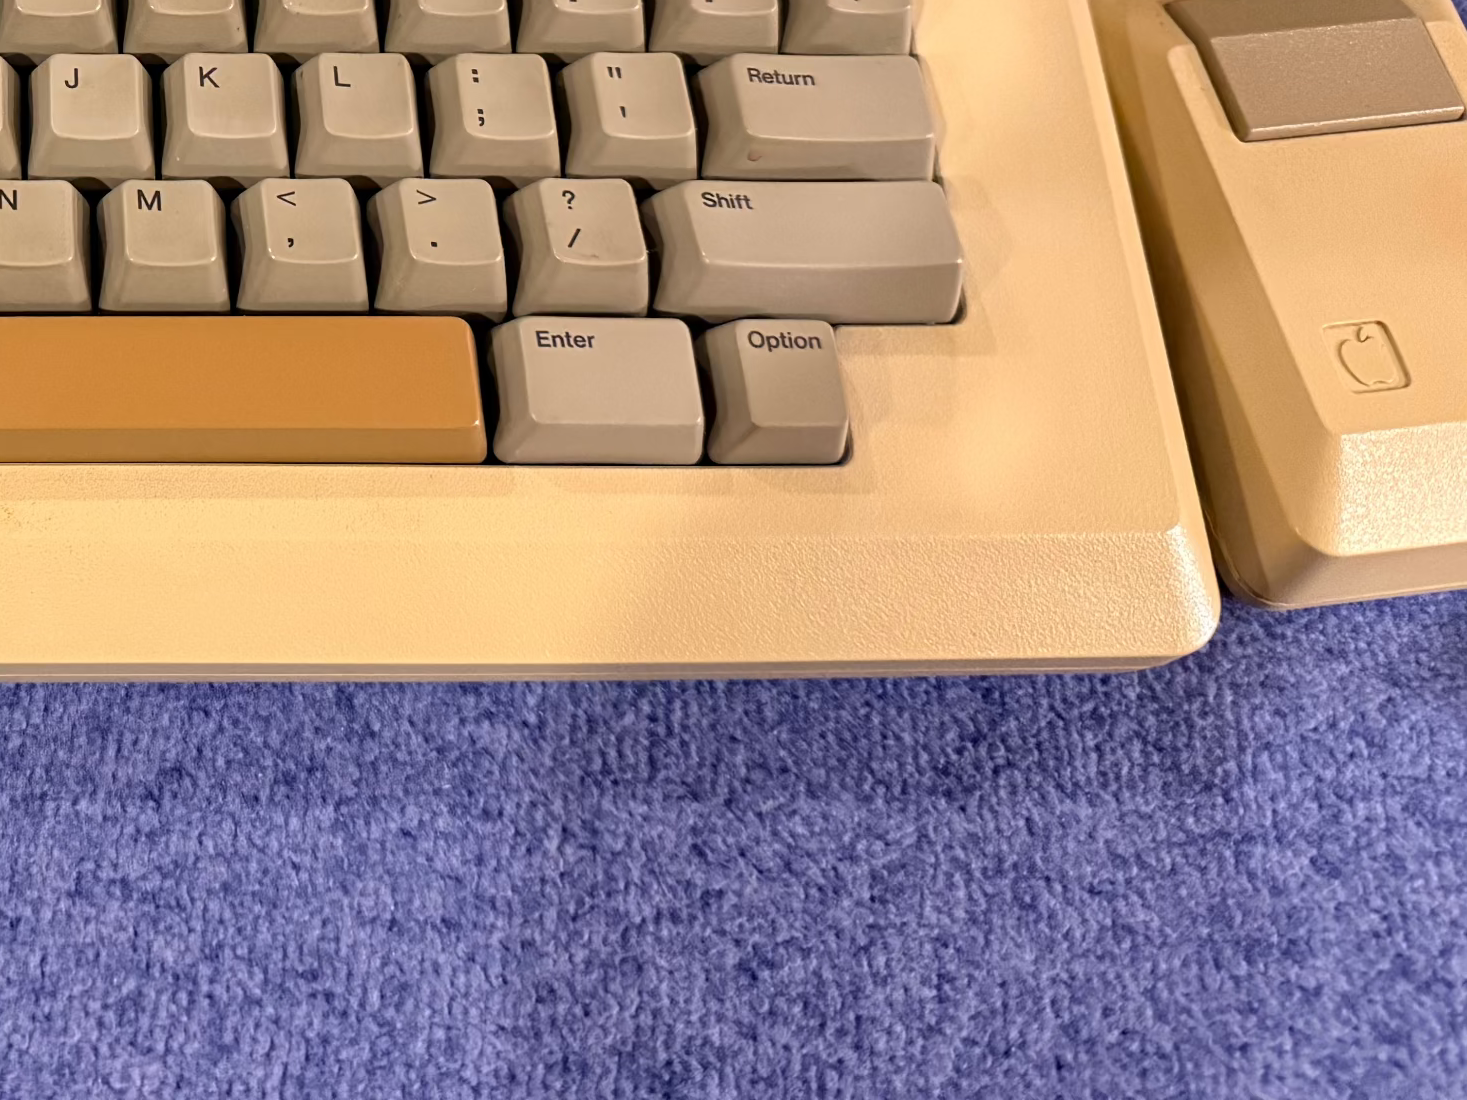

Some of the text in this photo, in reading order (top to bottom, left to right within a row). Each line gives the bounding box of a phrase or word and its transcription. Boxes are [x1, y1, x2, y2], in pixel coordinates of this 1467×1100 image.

[64, 67, 79, 89] J
[198, 66, 220, 89] K
[333, 65, 352, 88] L
[471, 68, 480, 84] :
[746, 67, 816, 86] Return
[476, 108, 485, 127] ;
[137, 188, 162, 212] M
[276, 191, 297, 207] <
[416, 189, 437, 205] >
[561, 189, 576, 210] ?
[701, 191, 754, 210] Shift
[287, 237, 295, 248] ,
[567, 228, 582, 248] /
[535, 330, 595, 349] Enter
[747, 330, 822, 353] Option
